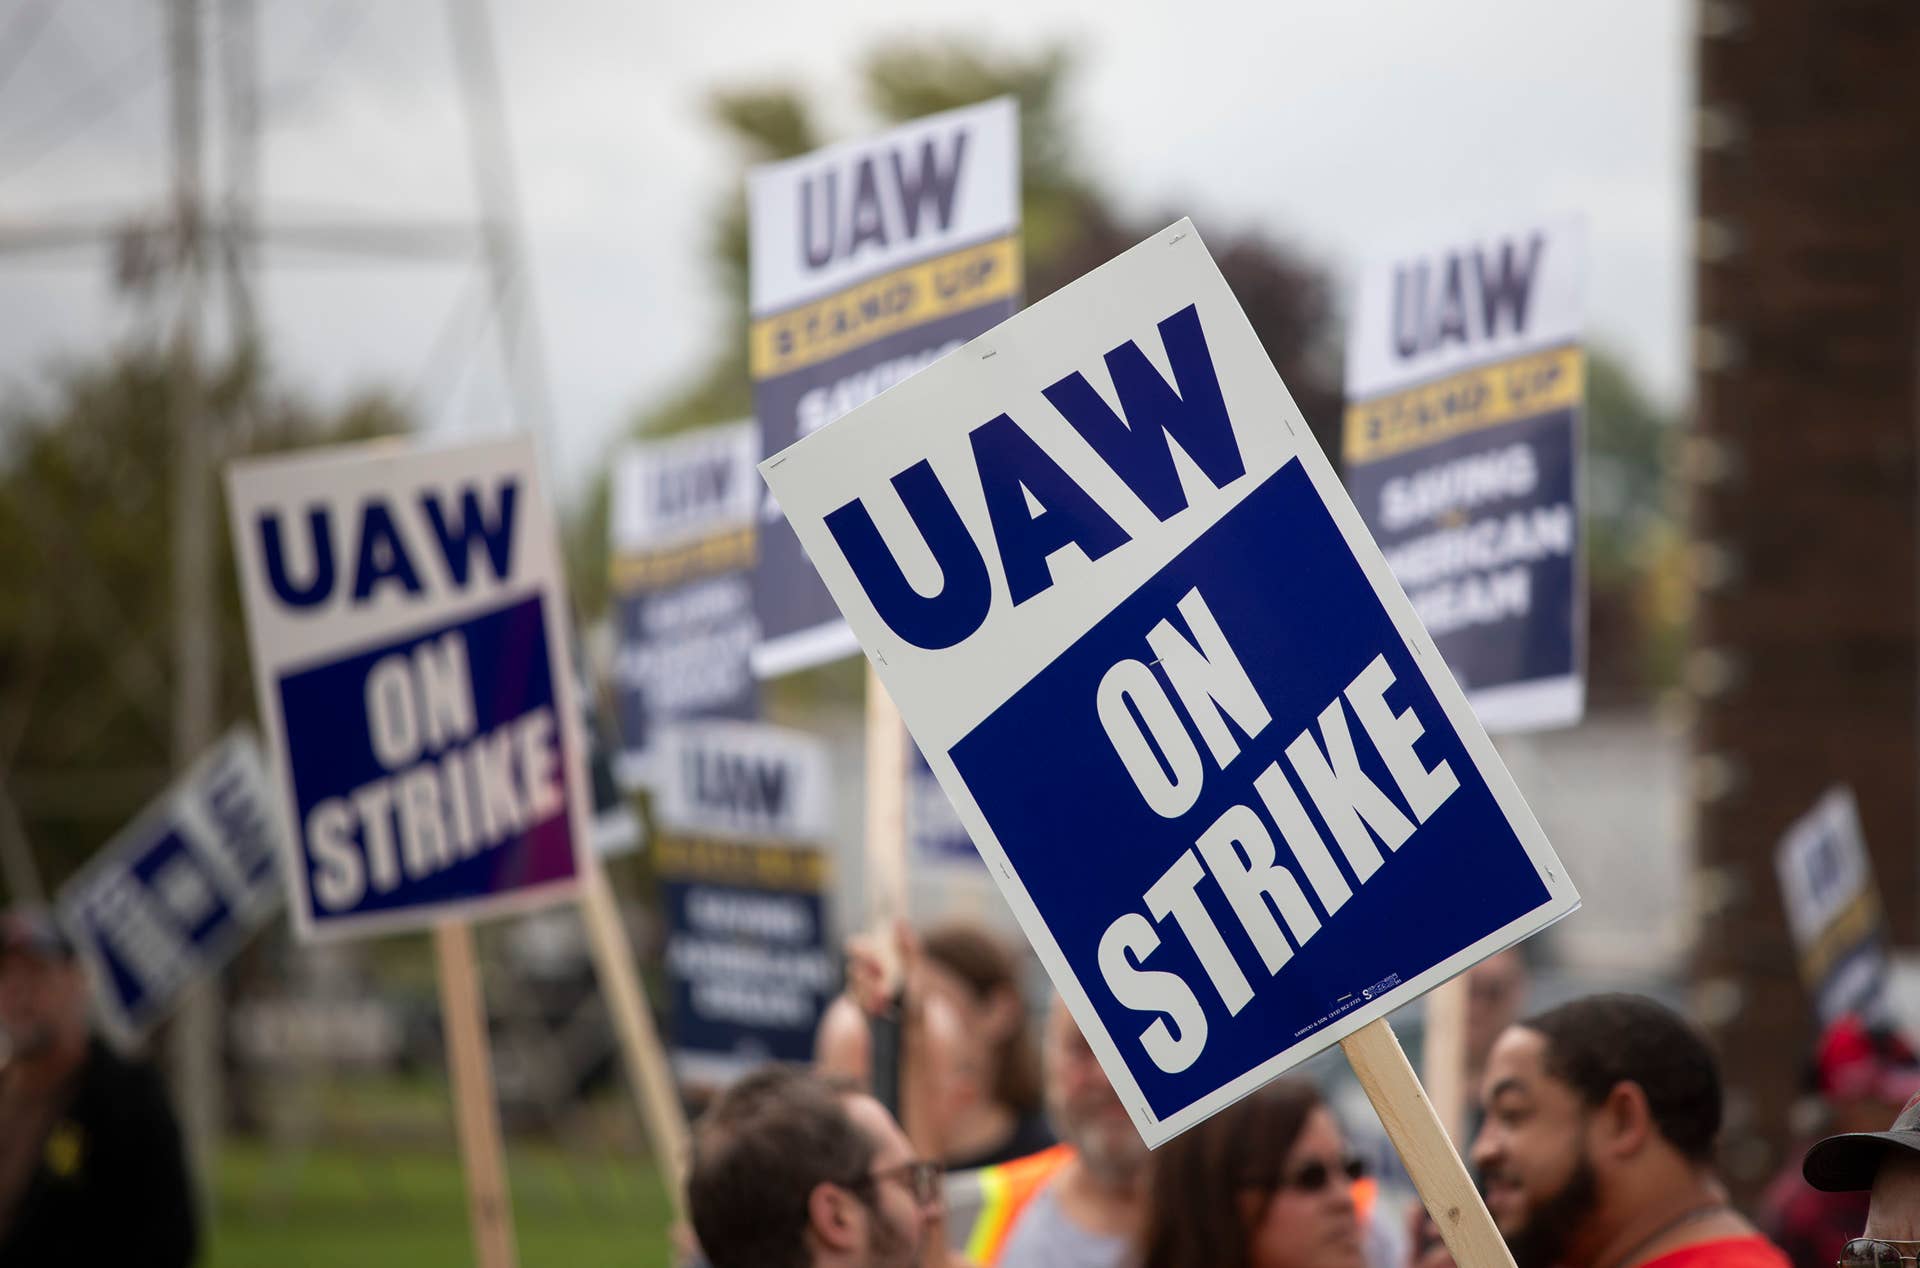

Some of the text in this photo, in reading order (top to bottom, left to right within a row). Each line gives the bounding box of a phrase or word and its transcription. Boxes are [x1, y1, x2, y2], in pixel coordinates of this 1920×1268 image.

[800, 127, 968, 270] UAW
[774, 257, 996, 357] STAND UP
[1393, 230, 1546, 359] UAW
[1366, 360, 1565, 440] STAND UP
[257, 476, 522, 613] UAW
[822, 303, 1247, 651] UAW
[363, 631, 477, 770] ON
[1096, 586, 1273, 819] ON
[305, 706, 566, 912] STRIKE
[1097, 652, 1462, 1074] STRIKE
